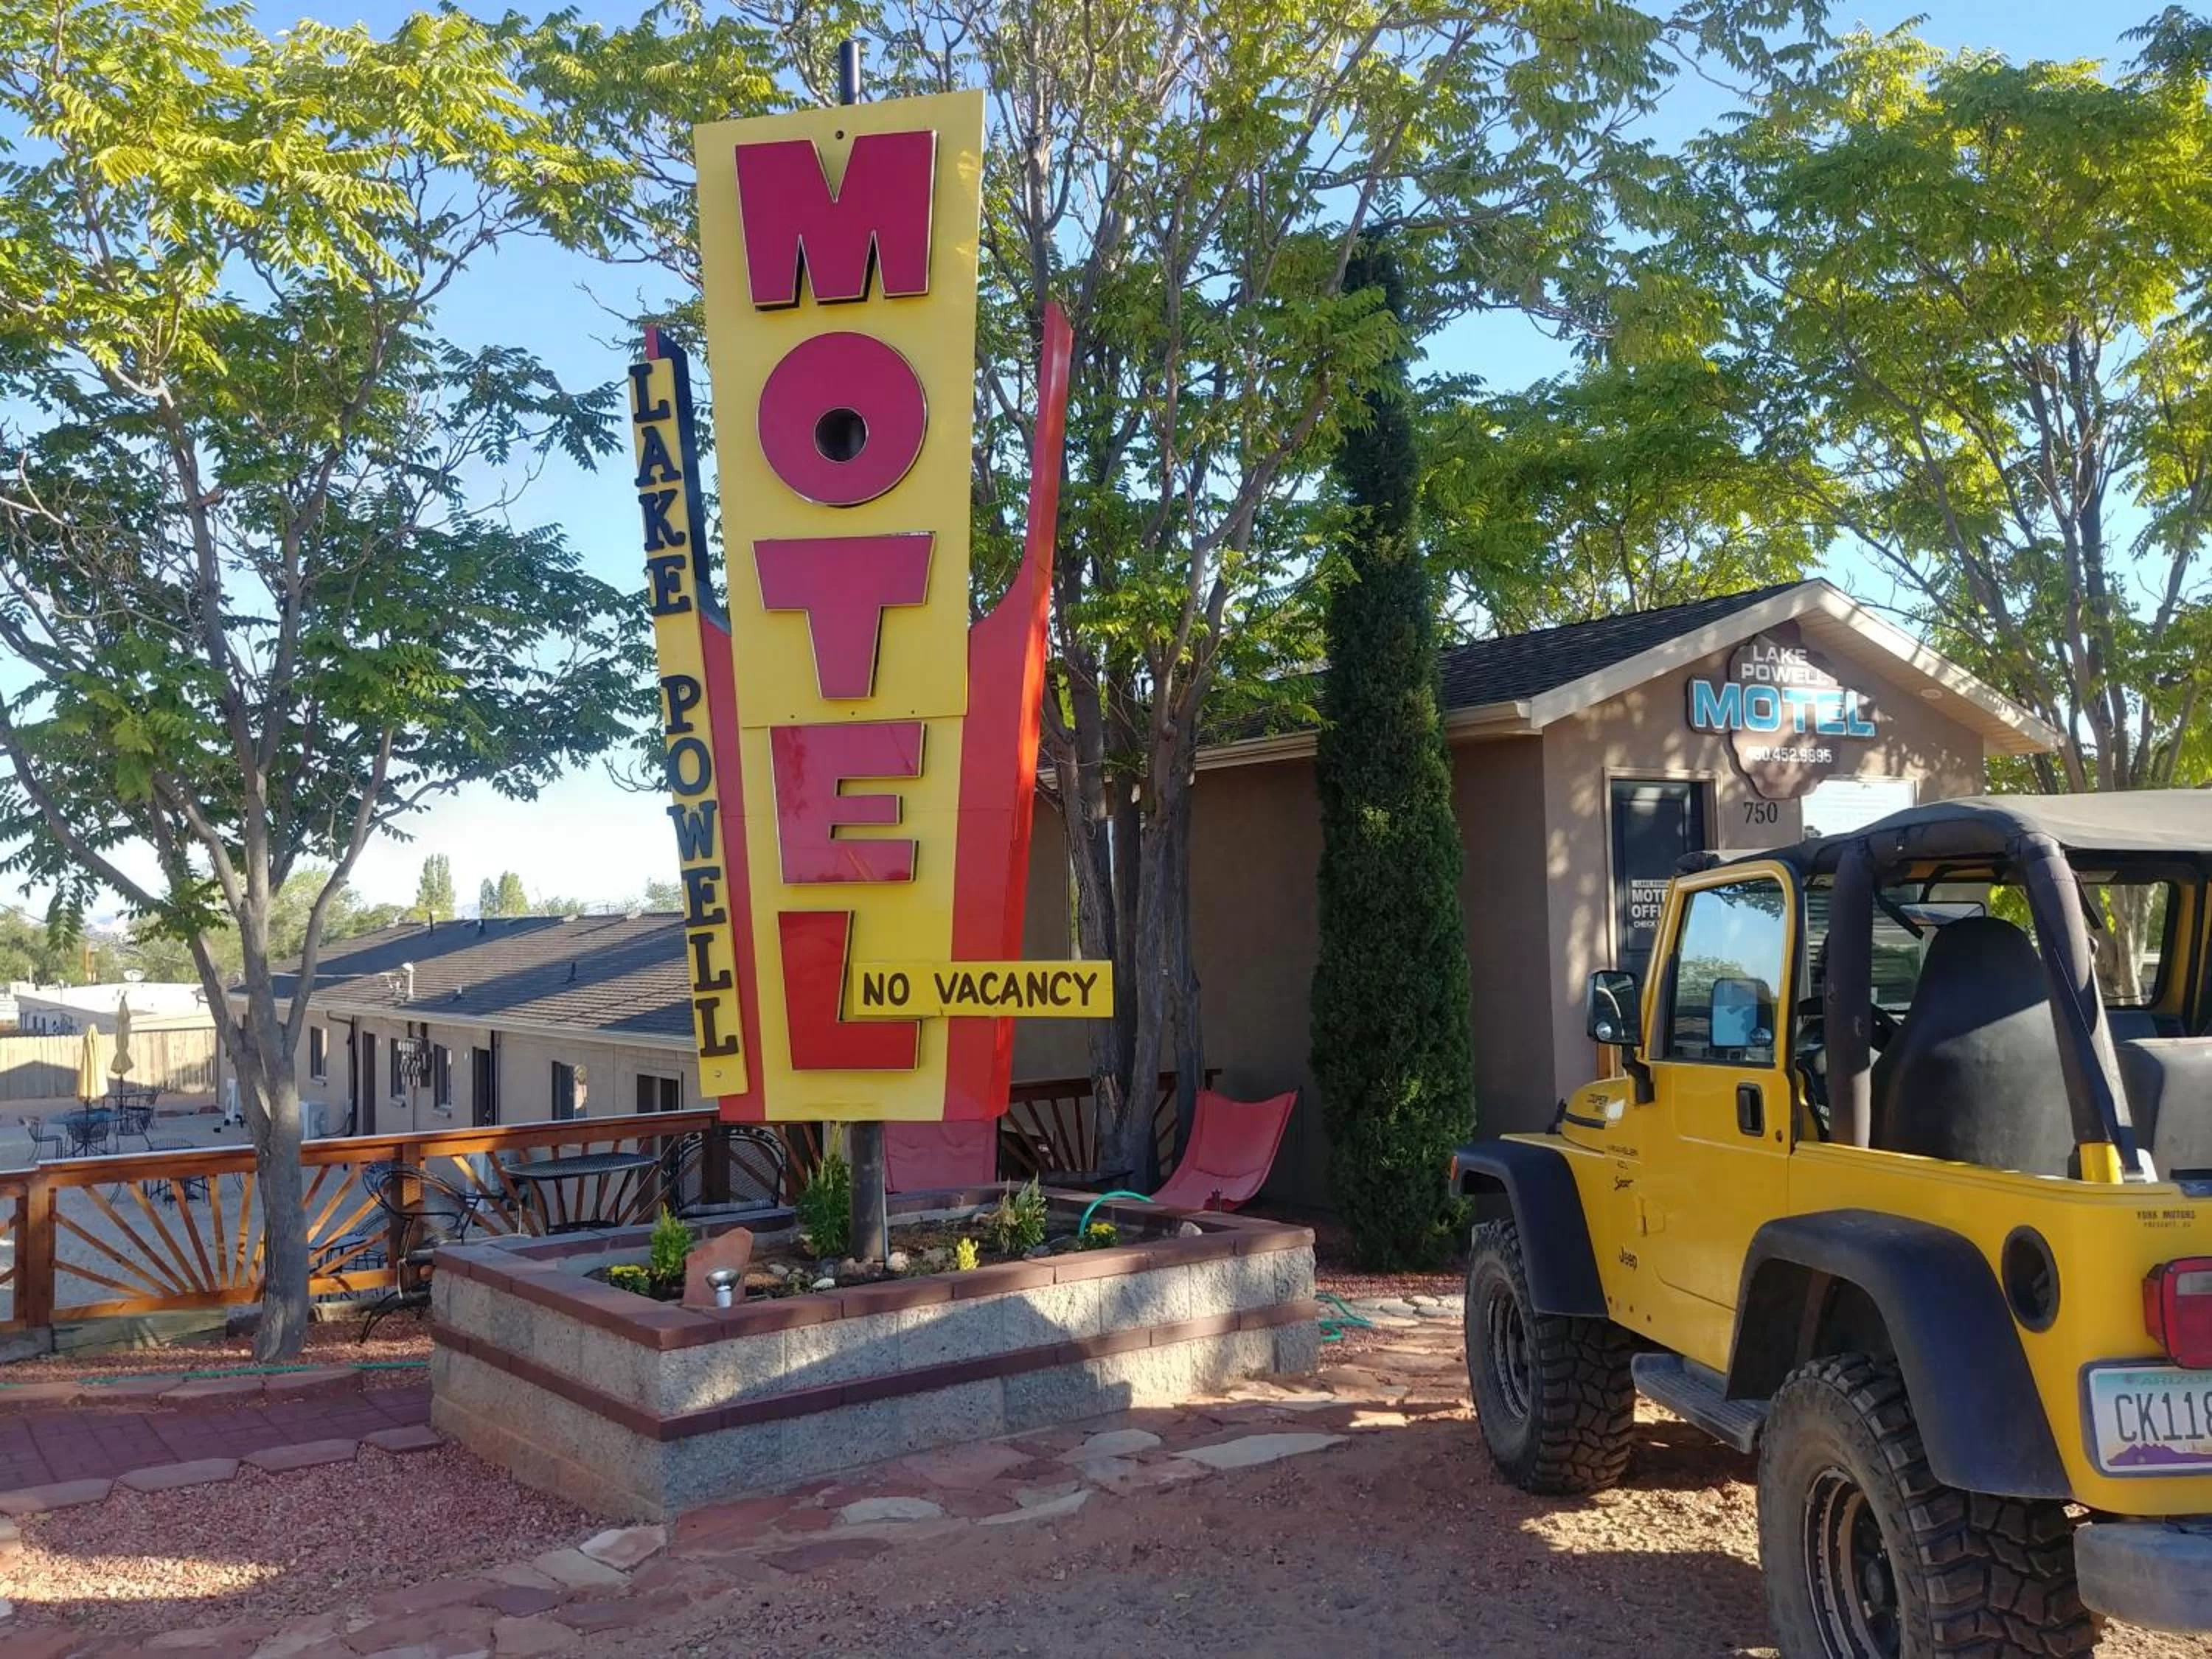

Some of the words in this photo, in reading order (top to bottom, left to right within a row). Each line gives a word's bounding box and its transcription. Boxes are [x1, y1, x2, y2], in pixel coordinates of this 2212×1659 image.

[735, 130, 936, 1071] MOTEL
[1753, 645, 1807, 664] LAKE
[628, 363, 692, 616] LAKE
[660, 675, 739, 1057] POWELL
[1692, 679, 1876, 737] MOTEL
[1743, 801, 1778, 824] 750
[1631, 905, 1661, 918] OFFI
[863, 972, 910, 1006] NO
[934, 970, 1098, 1006] VACANCY
[1618, 1246, 1638, 1271] Jeep
